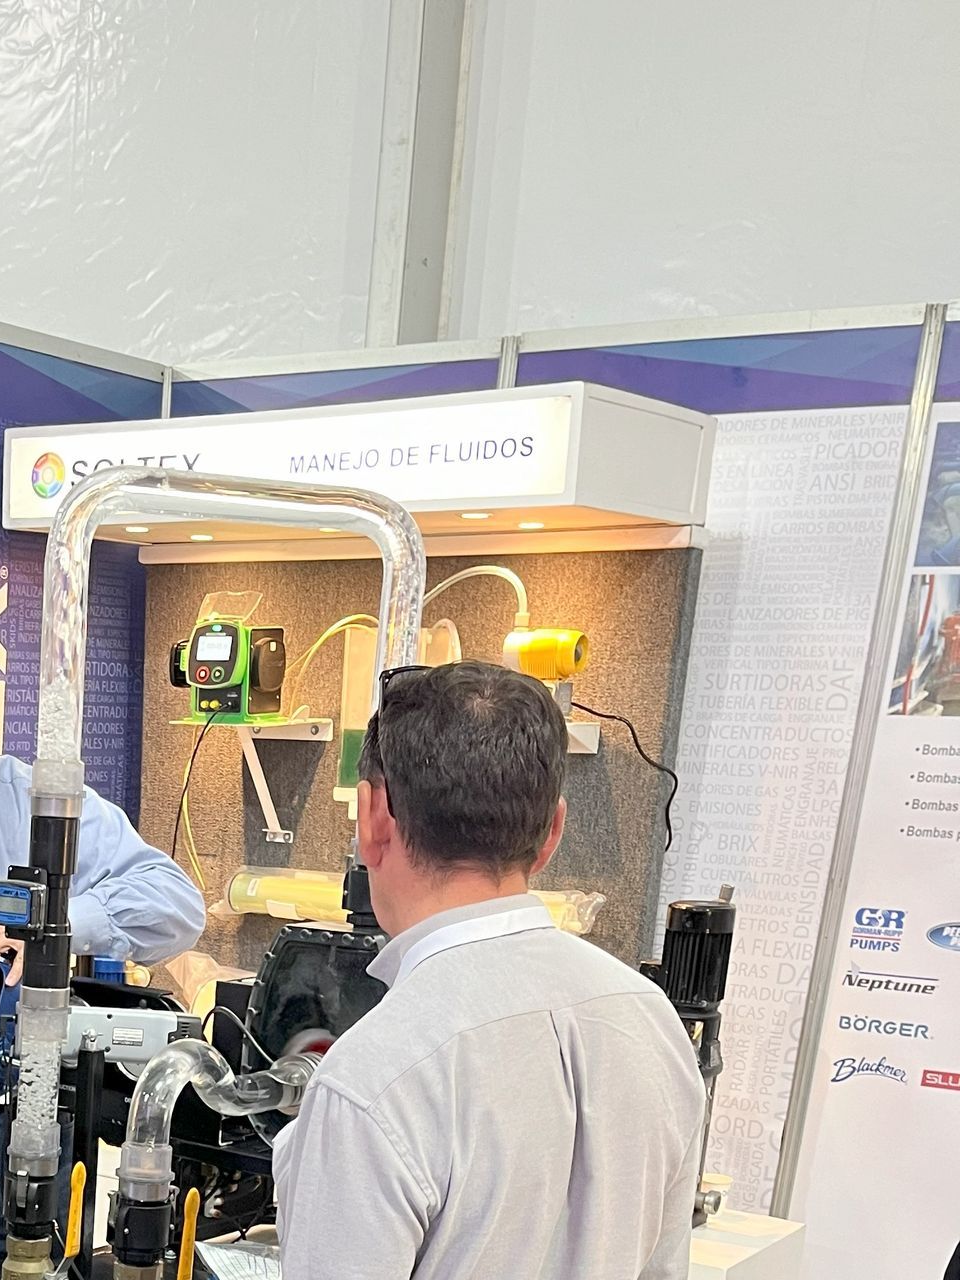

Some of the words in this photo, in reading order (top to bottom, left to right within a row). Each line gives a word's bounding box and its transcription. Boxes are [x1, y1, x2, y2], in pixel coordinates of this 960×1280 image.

[770, 417, 788, 431] DE
[792, 414, 866, 430] MINERALES
[289, 448, 380, 474] MANEJO
[390, 446, 420, 467] DE
[429, 436, 534, 464] FLUIDOS
[814, 440, 900, 460] PICADOR
[809, 472, 857, 491] ANSI
[823, 607, 844, 621] DE
[734, 645, 751, 657] DE
[753, 645, 825, 658] MINERALES
[703, 672, 828, 692] SURTIDORAS
[699, 693, 756, 710] TUBERÍA
[760, 696, 824, 711] FLEXIBLE
[758, 764, 800, 779] V-NIR
[736, 784, 754, 797] DE
[754, 785, 780, 798] GAS
[689, 800, 762, 816] EMISIONES
[911, 798, 959, 812] Bombas
[906, 825, 954, 839] Bombas
[716, 833, 761, 853] BRIX
[701, 867, 801, 887] CUENTALITROS
[793, 842, 825, 939] DENSIDAD
[849, 938, 901, 953] PUMPS
[842, 974, 937, 995] Neptune
[839, 1014, 930, 1040] BÖRGER
[730, 1038, 751, 1092] RADAR
[831, 1056, 908, 1084] Blackmer
